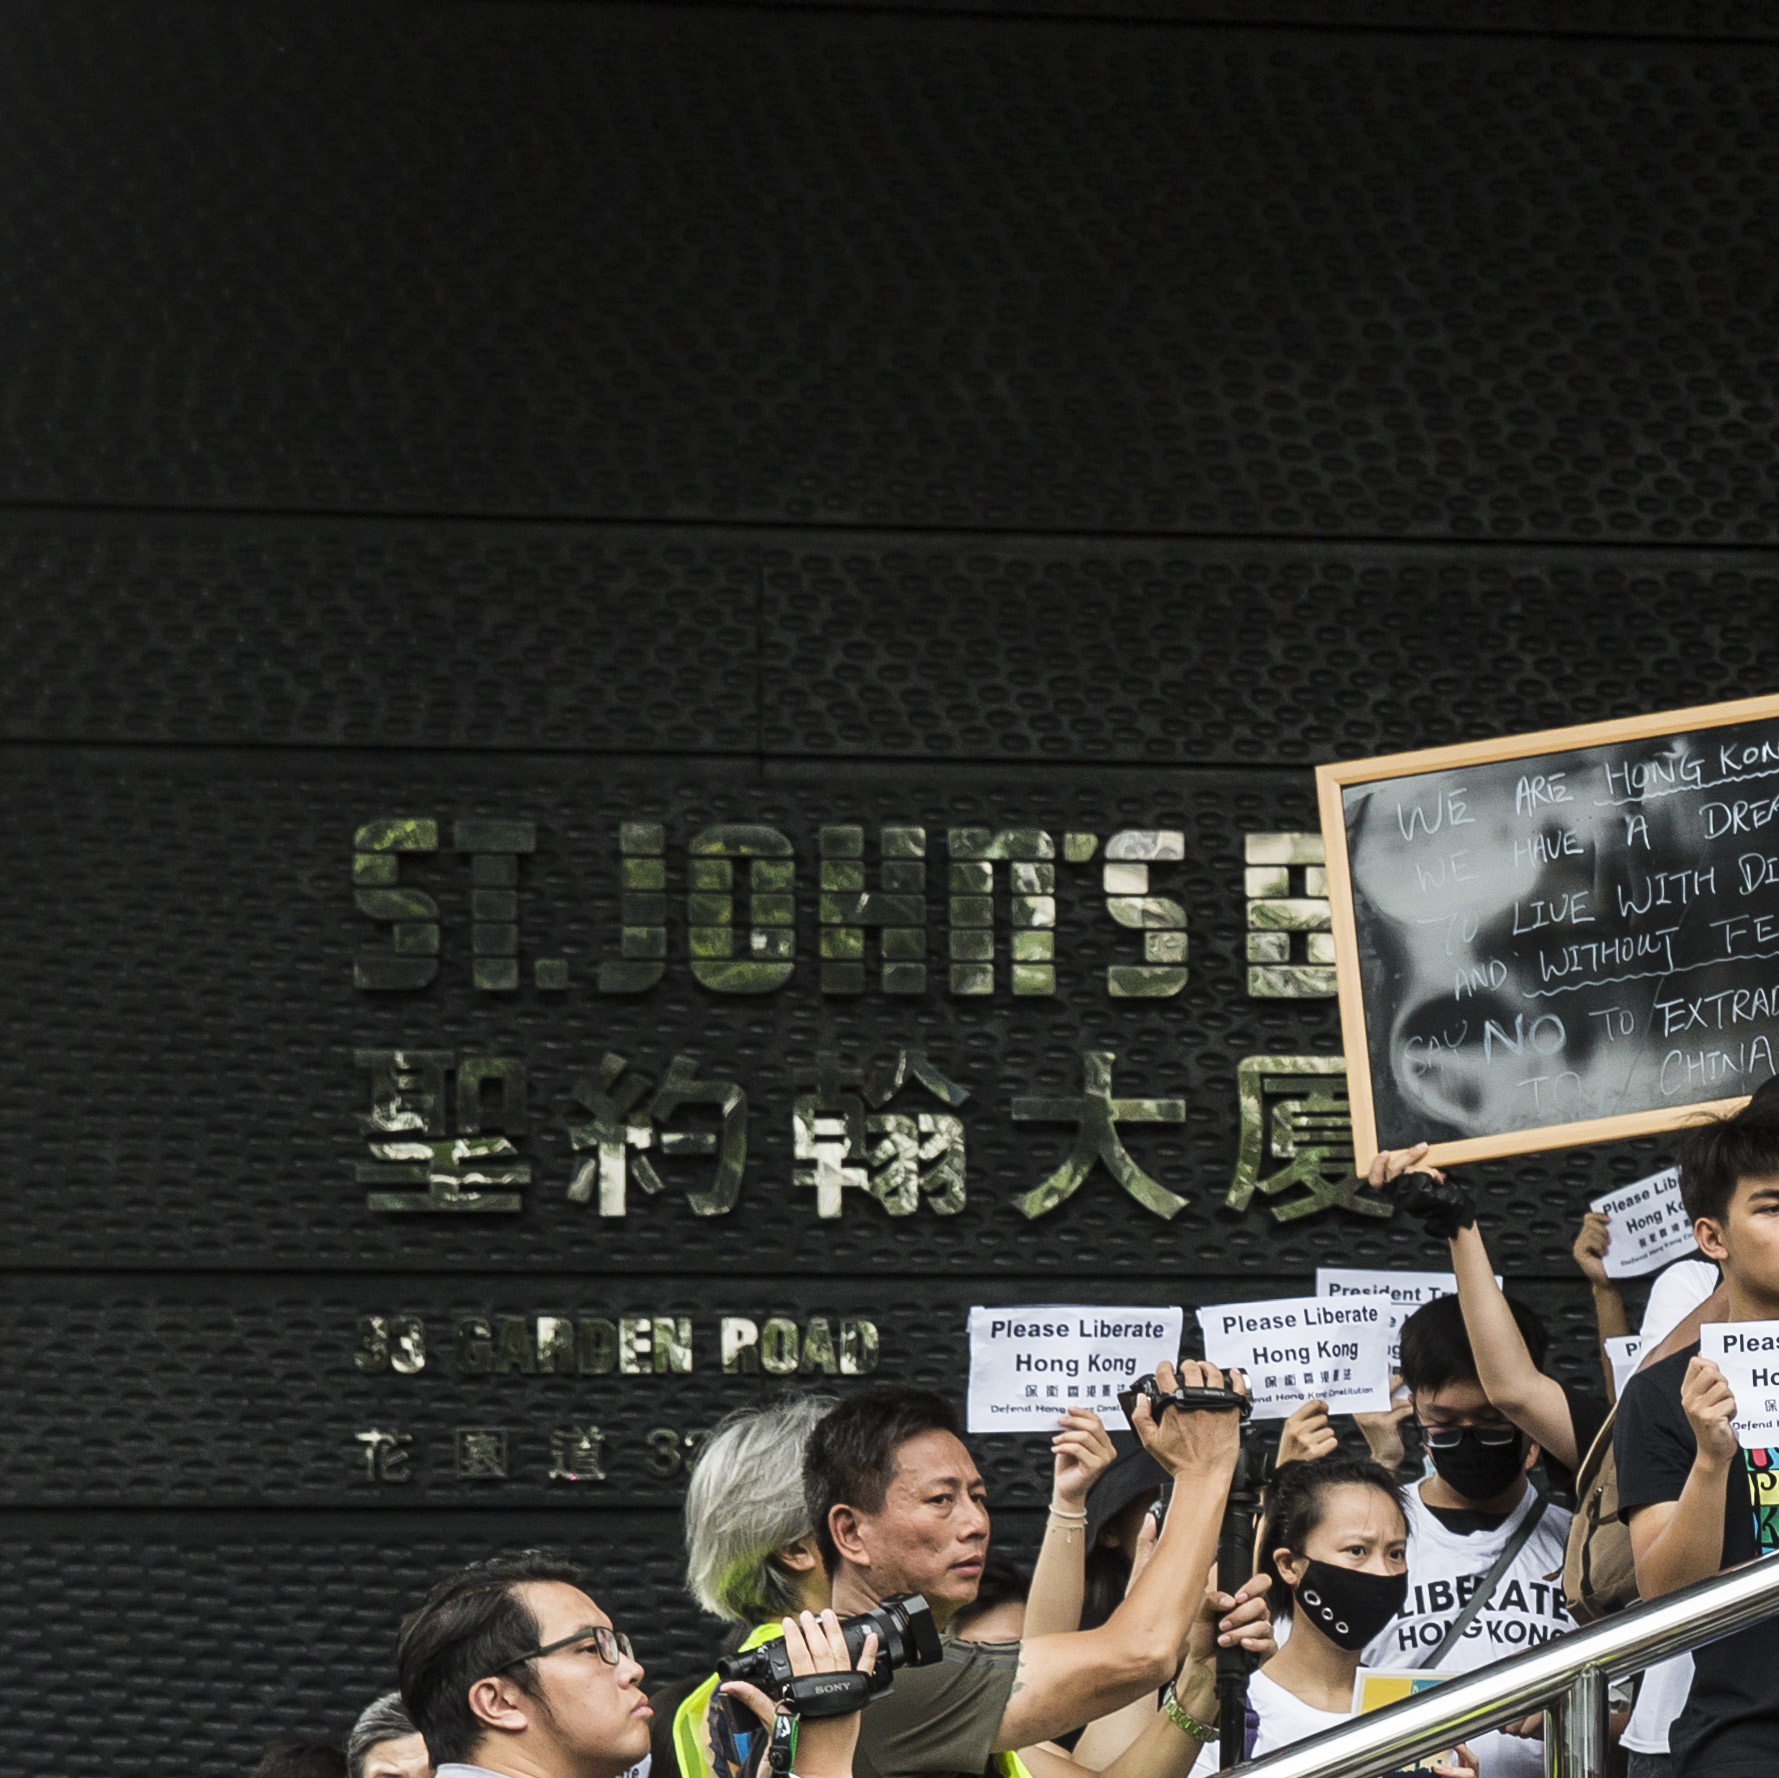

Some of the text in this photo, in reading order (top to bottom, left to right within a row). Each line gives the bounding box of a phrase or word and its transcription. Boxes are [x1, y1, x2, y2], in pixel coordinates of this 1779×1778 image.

[1397, 787, 1475, 842] WE
[1516, 772, 1575, 817] ARE
[1604, 753, 1706, 797] HONG
[1414, 854, 1480, 892] WE
[1514, 829, 1585, 868] HAVE
[1626, 815, 1651, 850] A
[1415, 914, 1478, 957] TO
[1512, 892, 1598, 936] LIVE
[1617, 868, 1718, 917] WITH
[1453, 960, 1508, 1001] AND
[1540, 926, 1680, 982] WITHOUT
[1404, 1022, 1470, 1068] SAY
[1483, 1013, 1567, 1065] NO
[1588, 1004, 1637, 1043] TO
[1659, 1035, 1777, 1097] CHINA
[1602, 1189, 1651, 1215] Please
[1626, 1210, 1663, 1235] Hong
[991, 1319, 1164, 1339] Please Liberate
[1222, 1306, 1378, 1335] Please Liberate
[456, 1315, 693, 1376] GARDEN
[719, 1315, 880, 1376] ROAD
[1252, 1340, 1359, 1365] Hong Kong
[1015, 1353, 1136, 1377] Hong Kong
[990, 1404, 1066, 1415] Defend Hong
[1275, 1392, 1305, 1402] Hong
[1732, 1420, 1773, 1431] Defend
[814, 1681, 851, 1695] SONY
